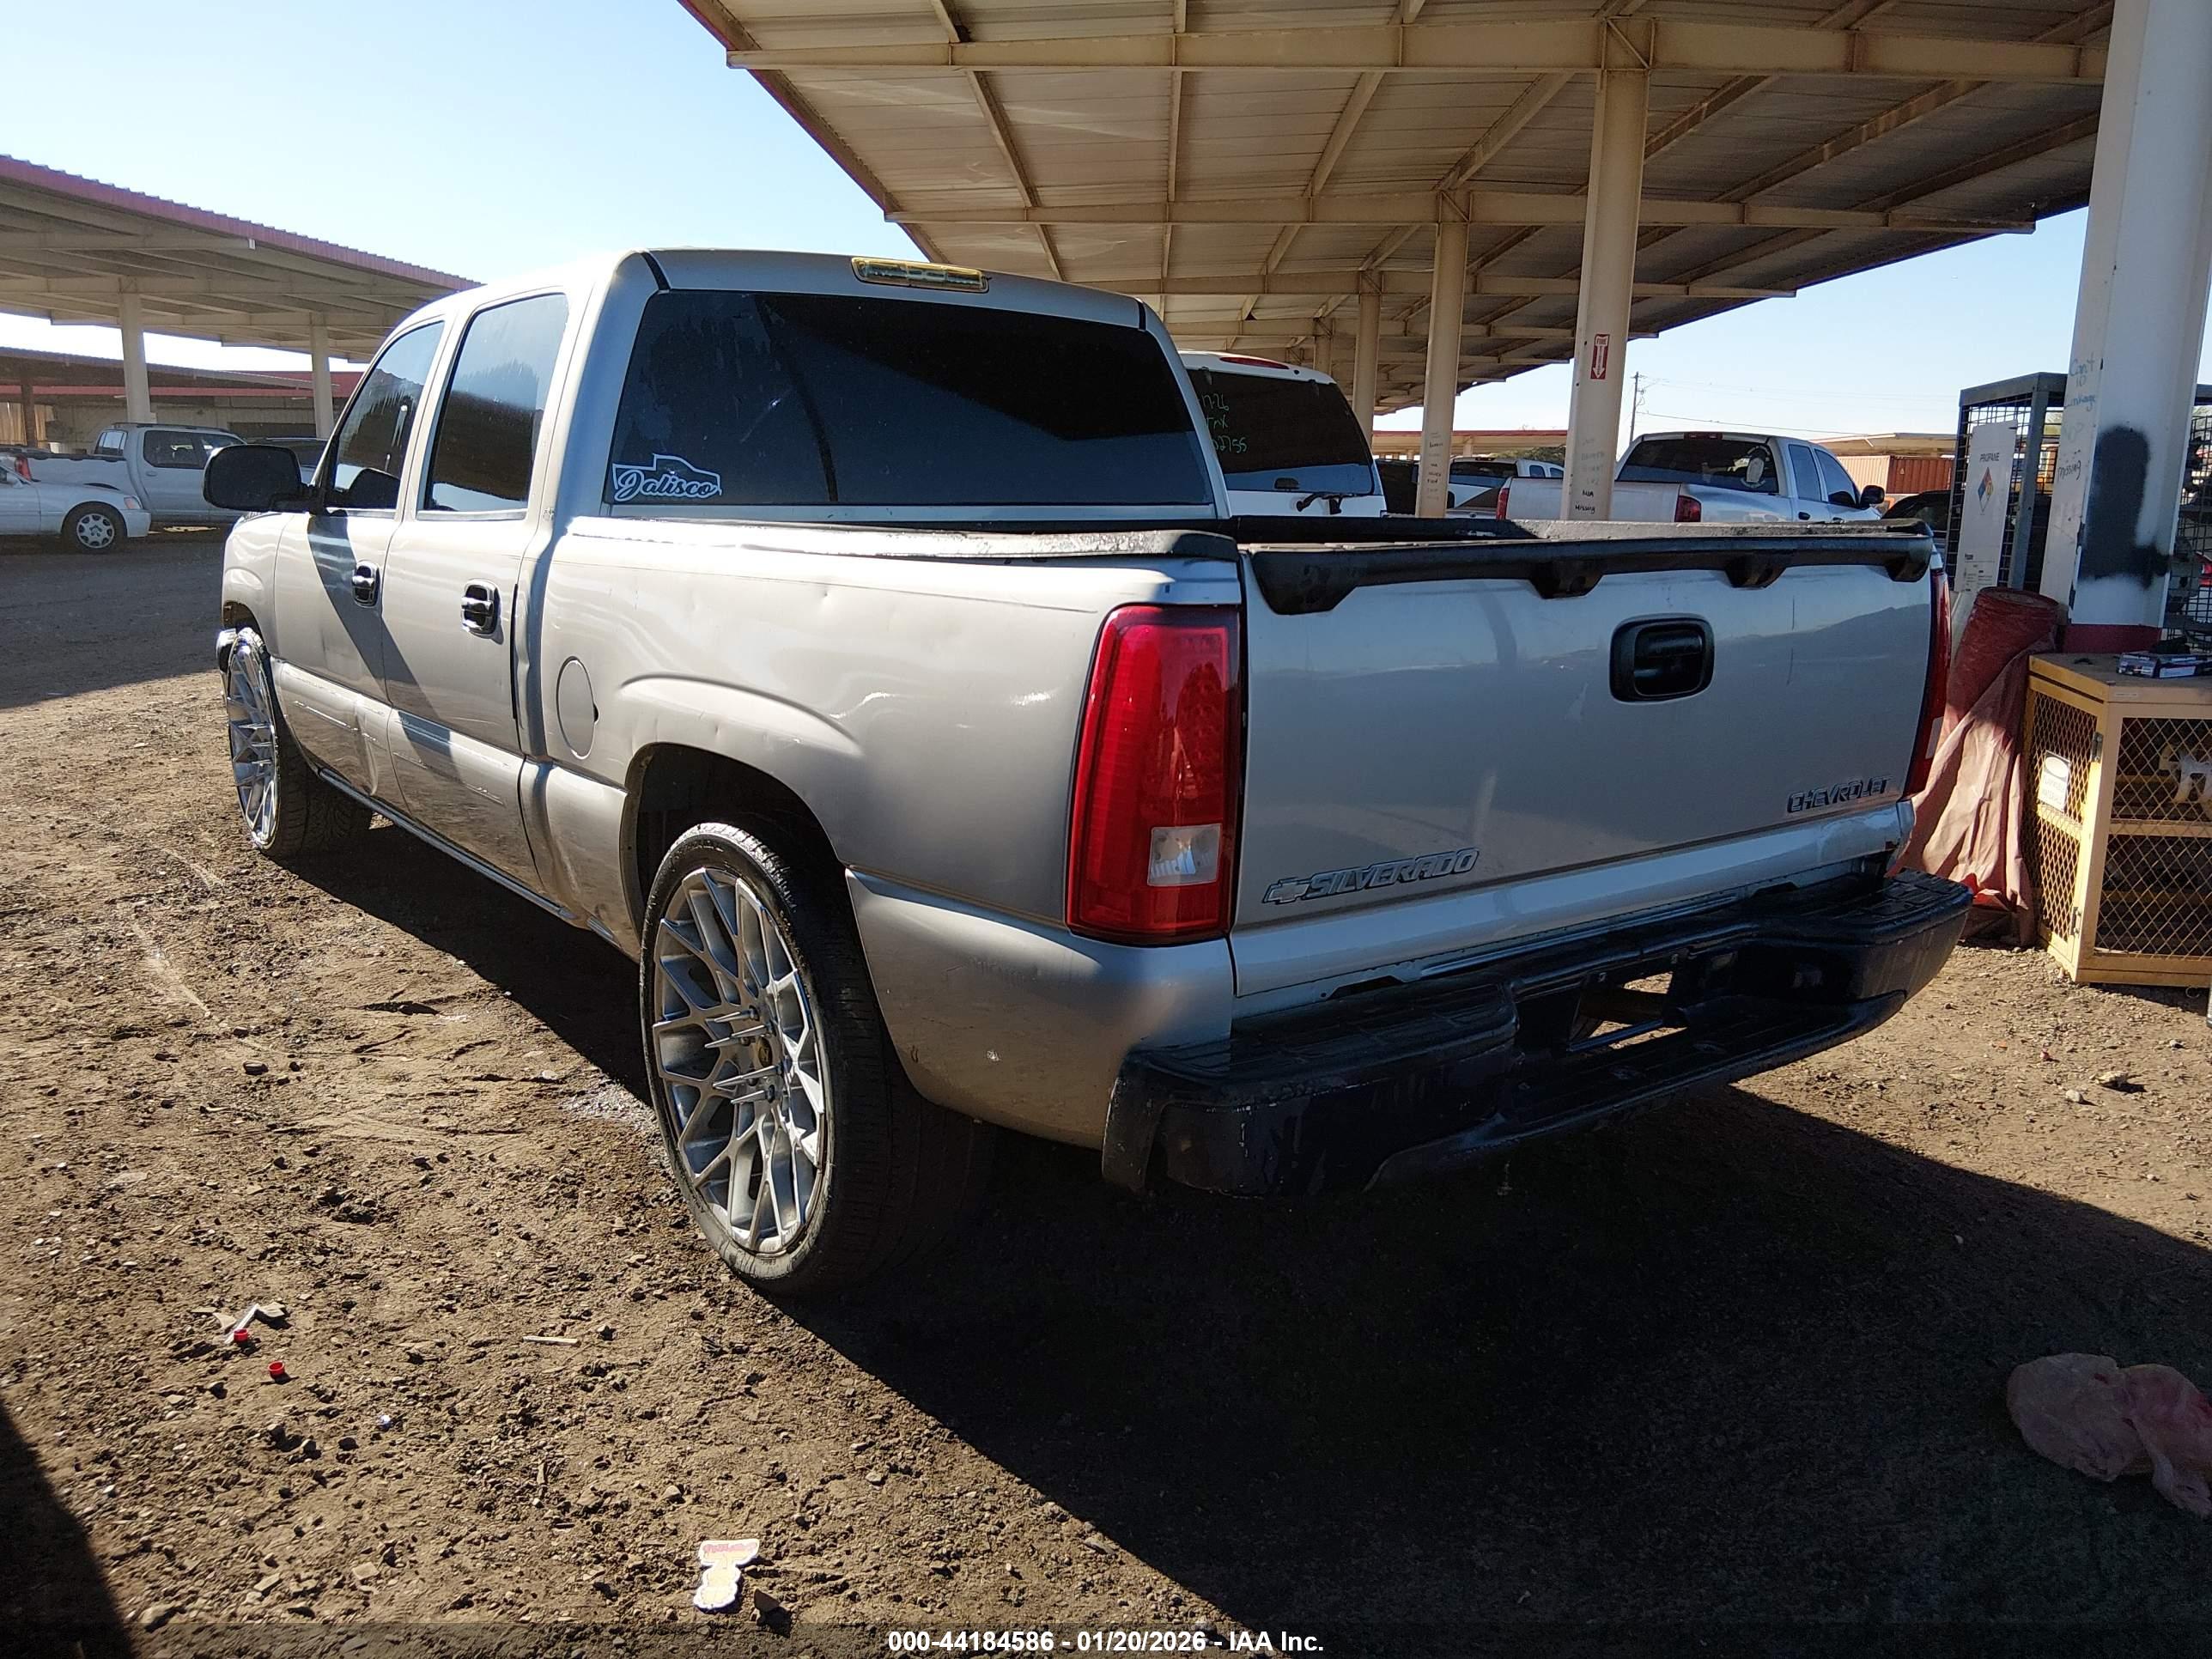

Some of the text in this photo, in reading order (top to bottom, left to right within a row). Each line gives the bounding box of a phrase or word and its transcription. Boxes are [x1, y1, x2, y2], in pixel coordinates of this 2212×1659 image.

[1979, 452, 2000, 462] PROPANE
[615, 470, 720, 502] Jalisco
[1787, 775, 1892, 813] CHEVROLET
[1301, 846, 1480, 900] SILVERADO
